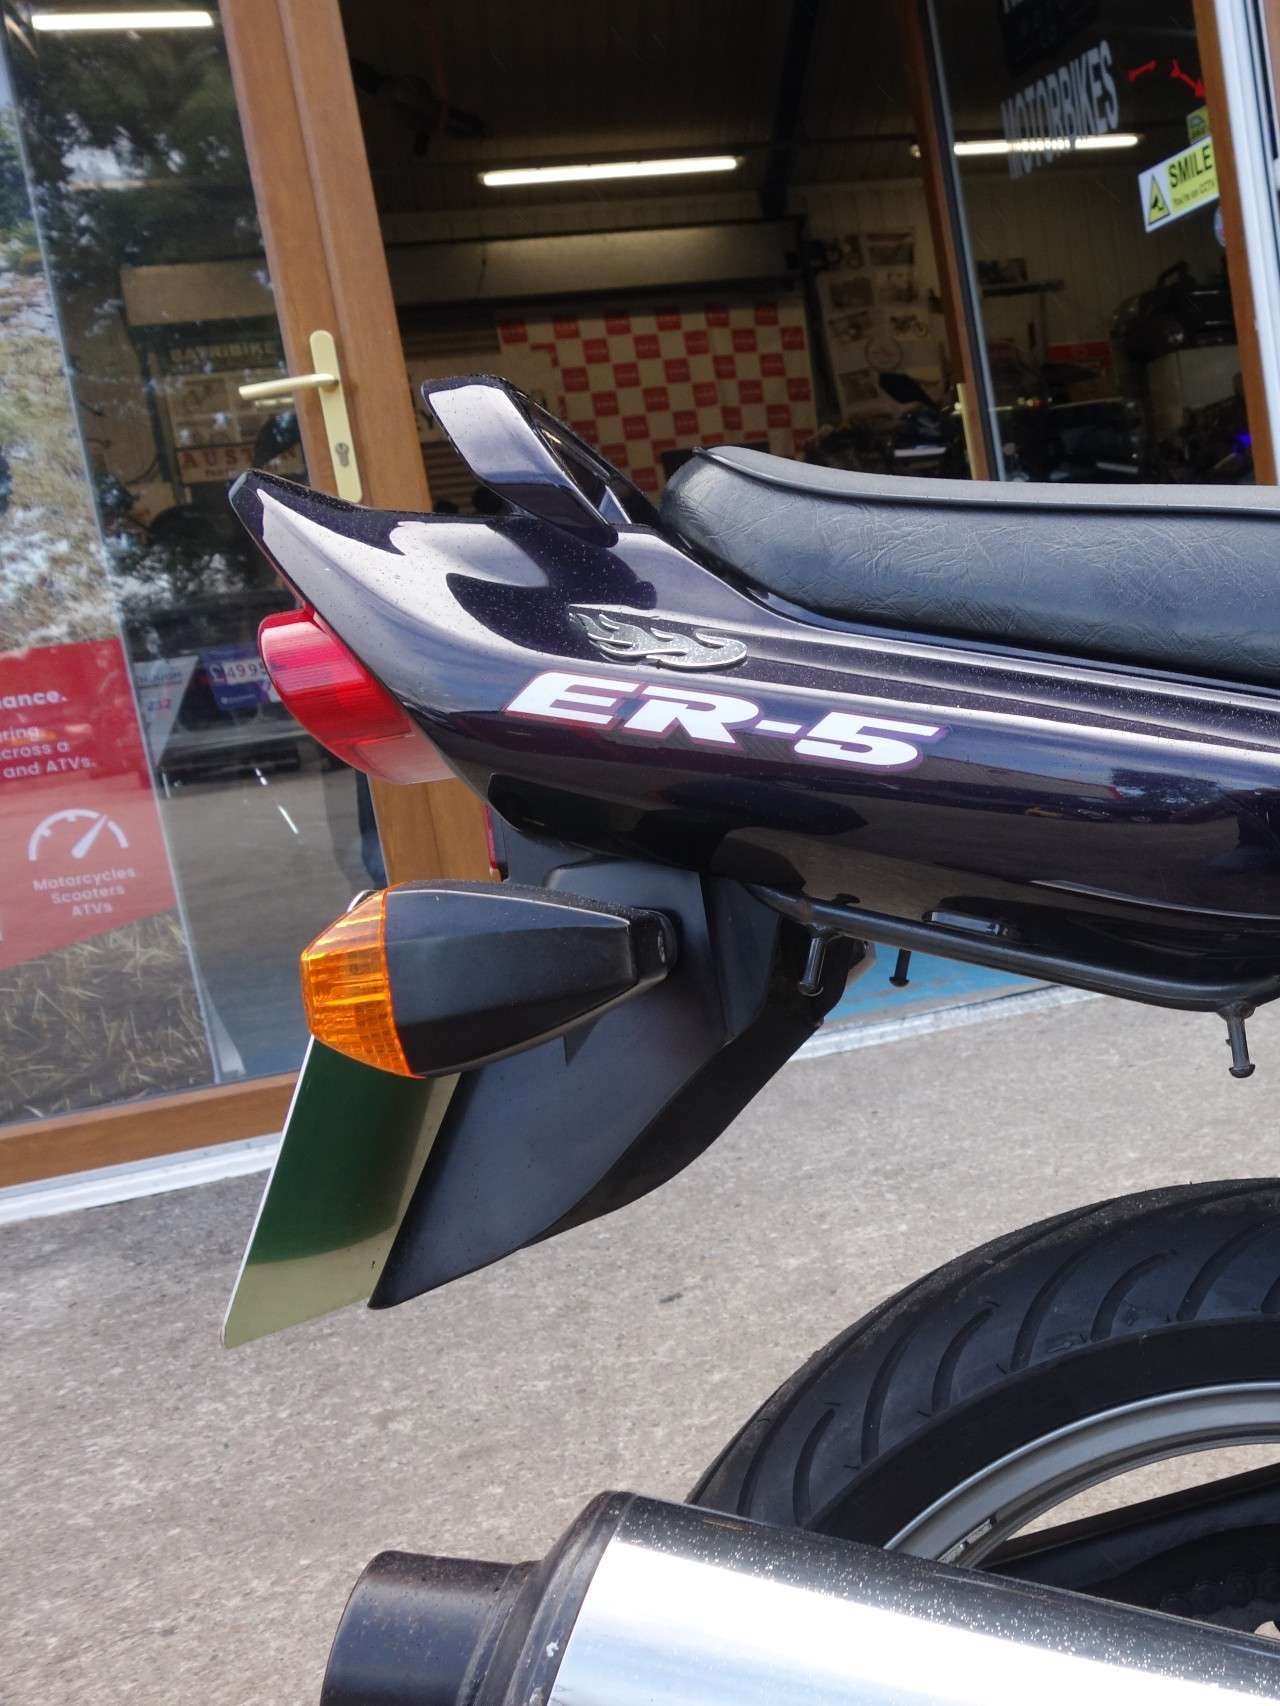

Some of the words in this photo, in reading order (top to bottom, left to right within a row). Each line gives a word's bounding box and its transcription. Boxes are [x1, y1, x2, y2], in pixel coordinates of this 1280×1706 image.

[1000, 39, 1119, 179] MOTORBIKES
[1168, 144, 1213, 188] SMILE
[0, 690, 68, 710] ance.
[504, 670, 944, 768] ER-5
[0, 726, 40, 743] ring
[0, 744, 52, 761] cross
[3, 761, 40, 778] and
[47, 756, 97, 773] ATVs.
[33, 867, 136, 892] Motorcycles
[52, 886, 124, 905] Scooters
[71, 902, 113, 917] ATVs
